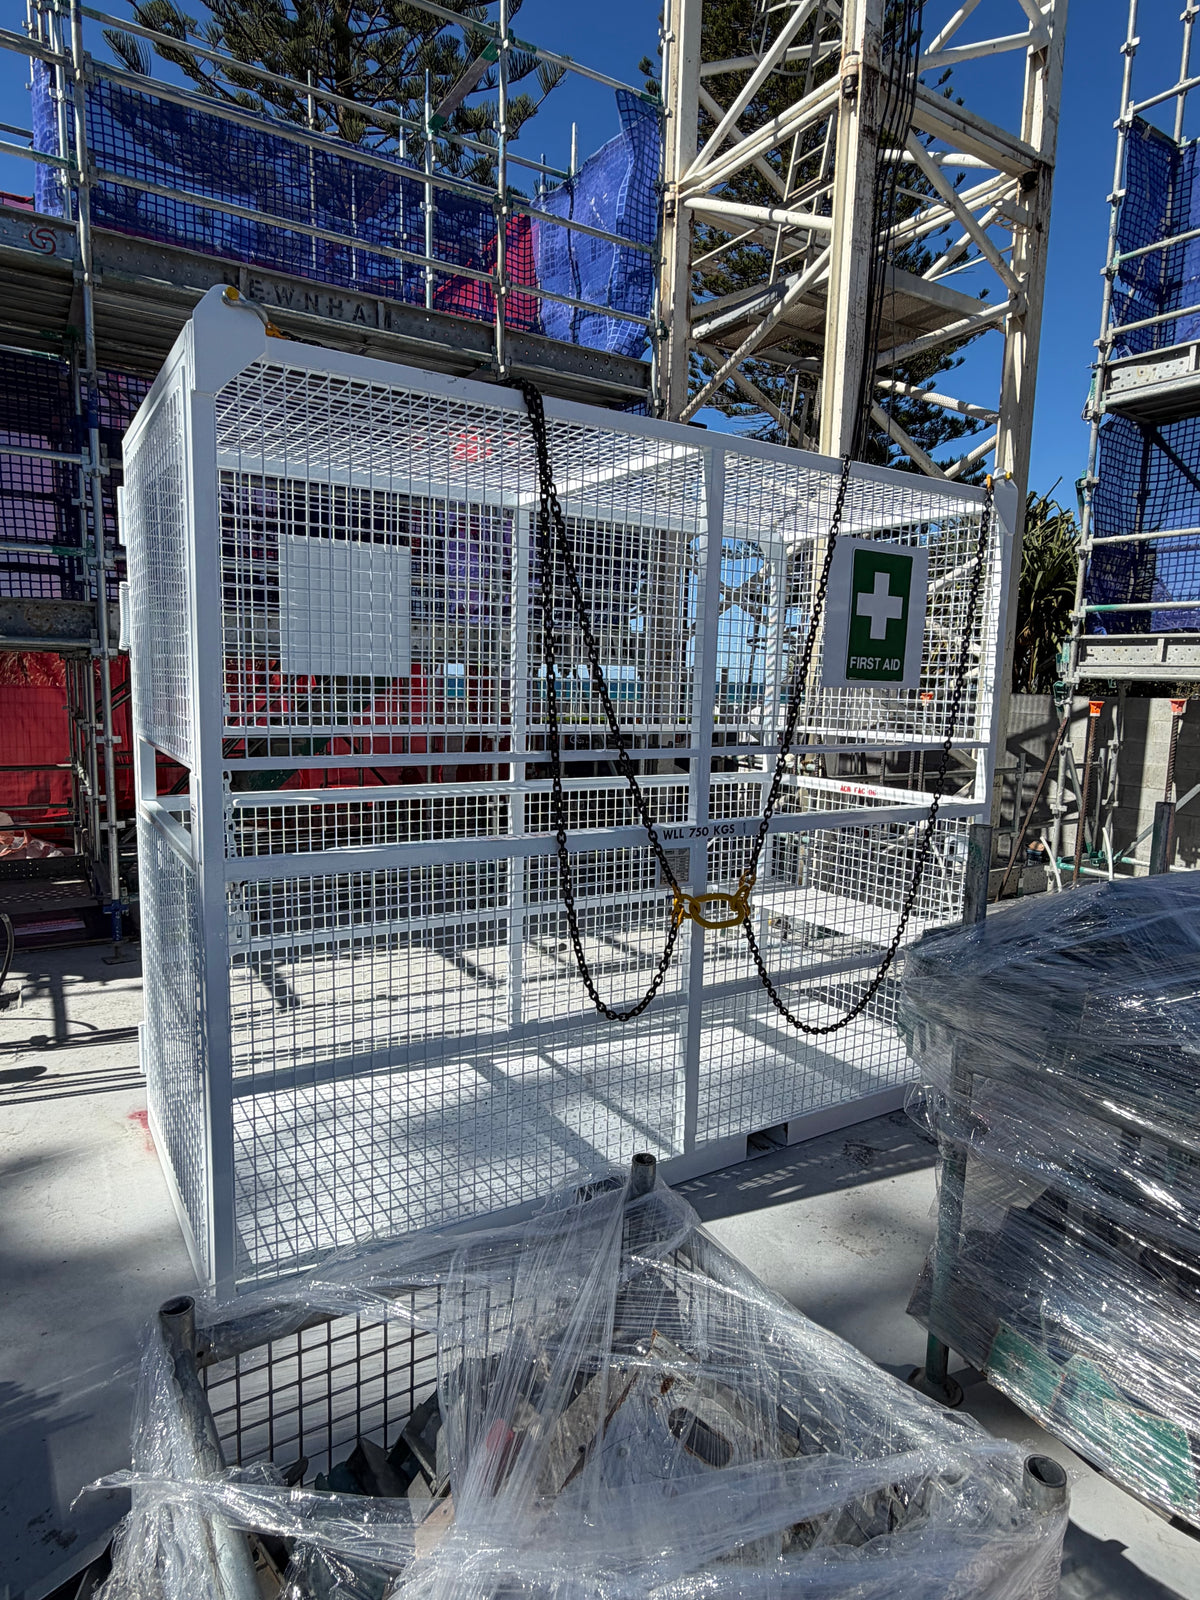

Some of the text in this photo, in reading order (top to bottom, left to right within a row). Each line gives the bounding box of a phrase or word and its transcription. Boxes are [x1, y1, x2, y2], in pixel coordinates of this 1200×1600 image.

[850, 656, 900, 671] FIRST AID
[663, 824, 735, 840] WLL 750 KGS
